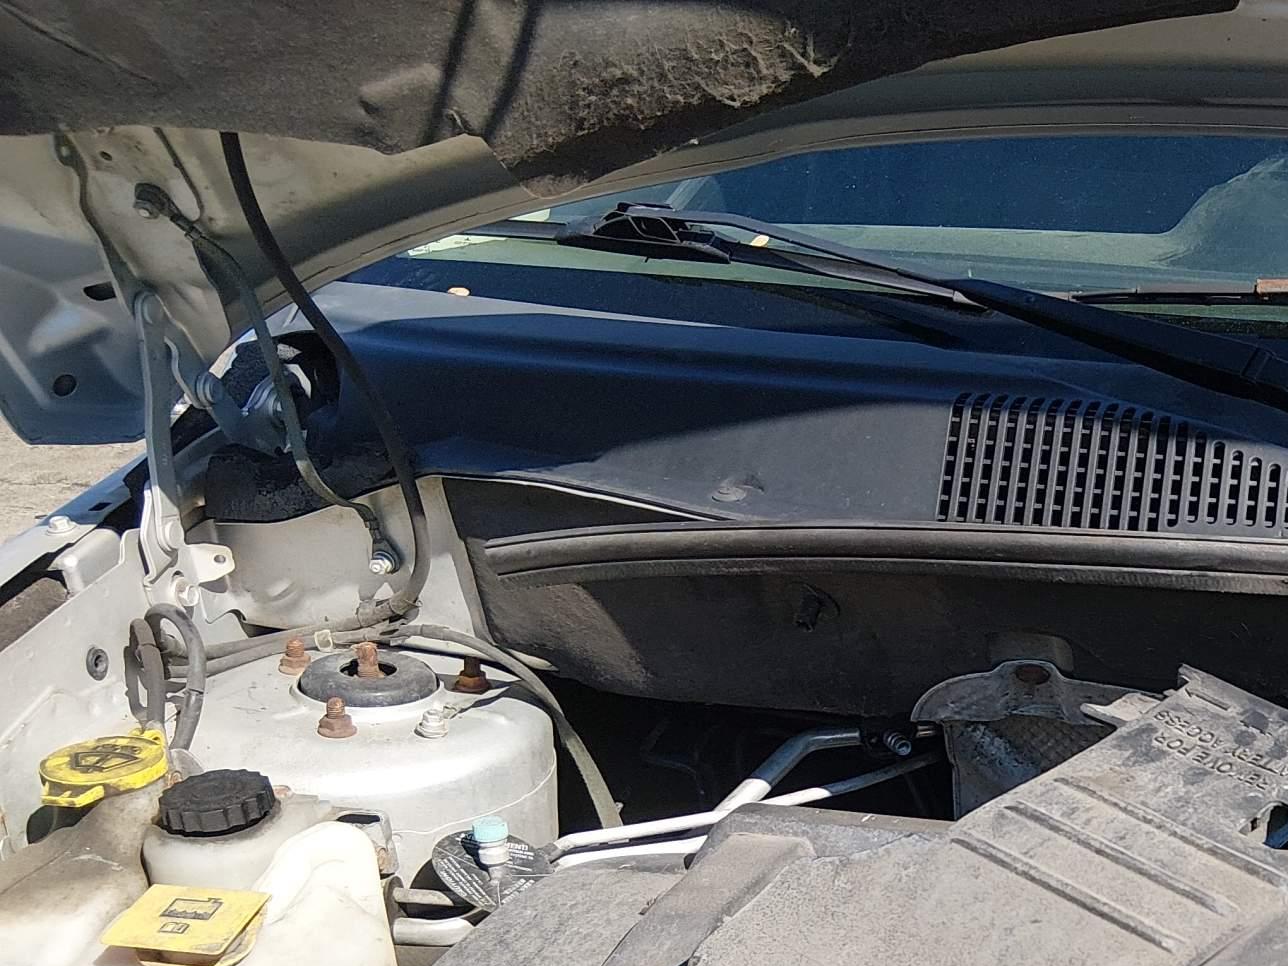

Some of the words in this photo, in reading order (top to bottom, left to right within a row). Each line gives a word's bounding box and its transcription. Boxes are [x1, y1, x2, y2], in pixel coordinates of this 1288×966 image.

[1154, 710, 1224, 749] ACCESS
[1154, 732, 1197, 757] FOR
[1192, 750, 1269, 791] REMOVE
